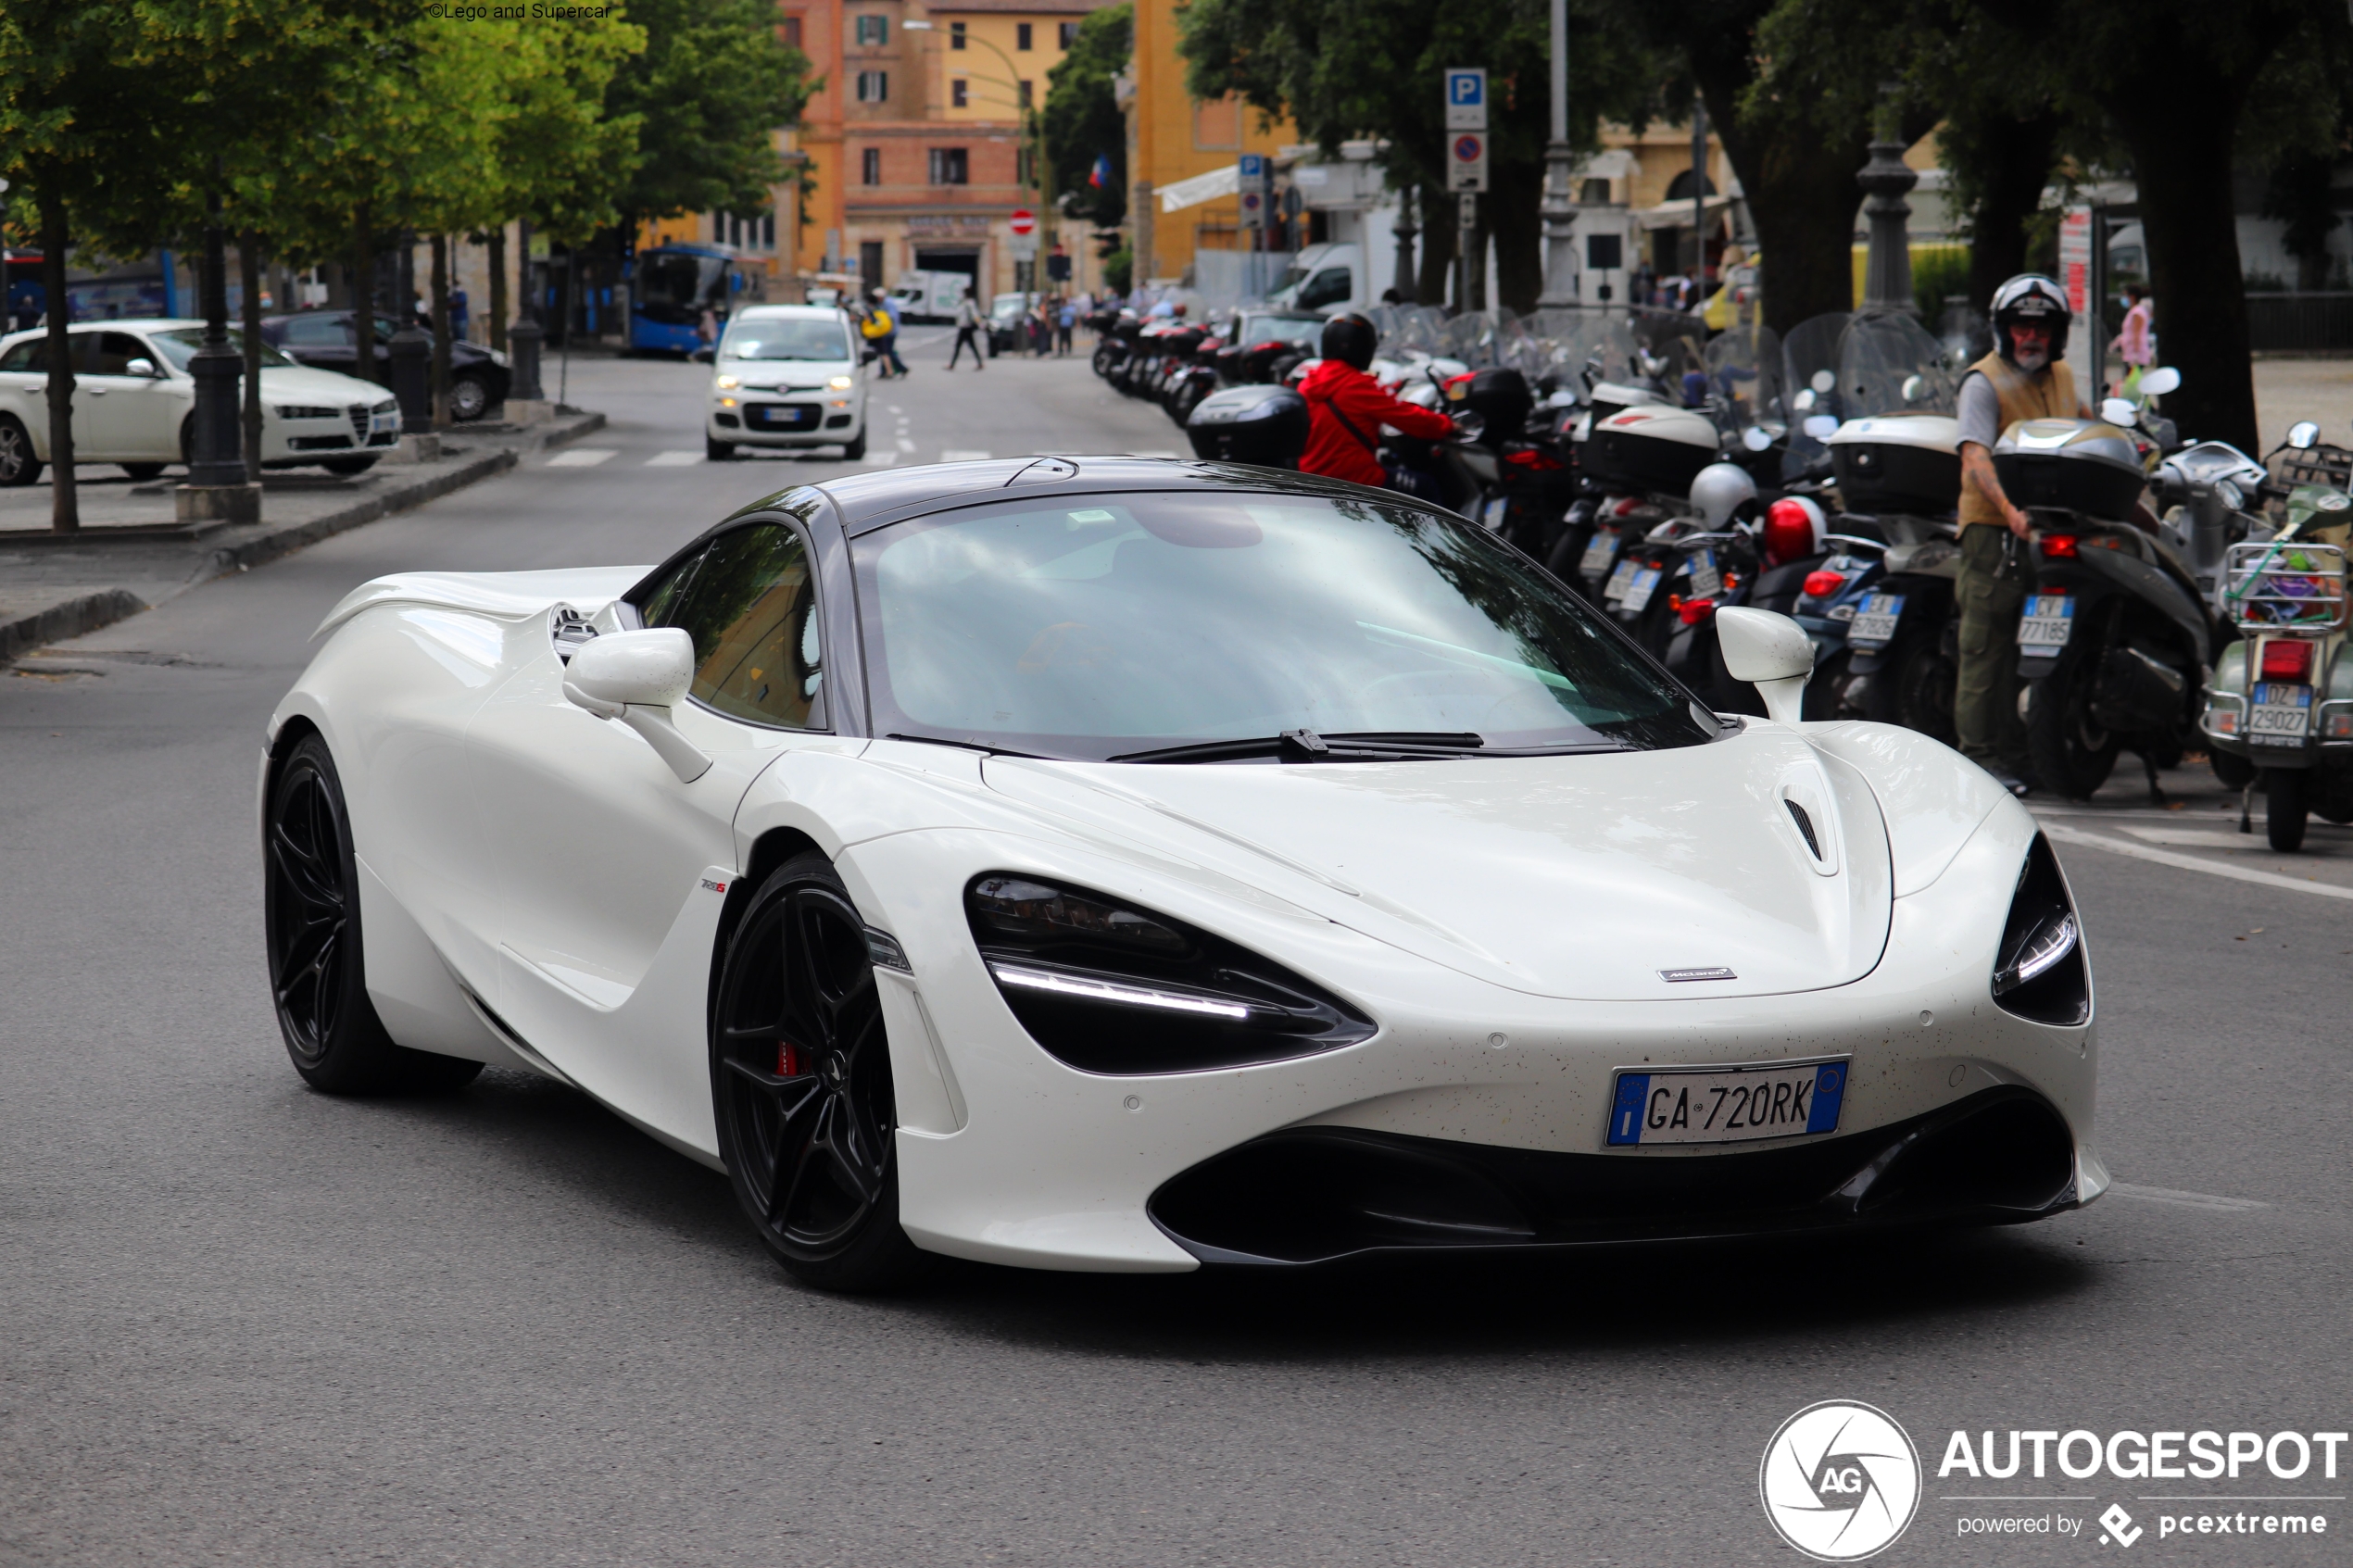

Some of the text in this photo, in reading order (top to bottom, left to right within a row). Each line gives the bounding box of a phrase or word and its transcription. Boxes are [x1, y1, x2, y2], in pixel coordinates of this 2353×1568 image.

[1456, 78, 1477, 103] P
[1244, 158, 1257, 173] P
[2036, 597, 2058, 618] CV
[2020, 621, 2070, 642] 77185
[2268, 685, 2290, 706] DZ
[2253, 709, 2306, 731] 29027
[1647, 1086, 1689, 1129] GA
[1703, 1078, 1814, 1130] 720RK
